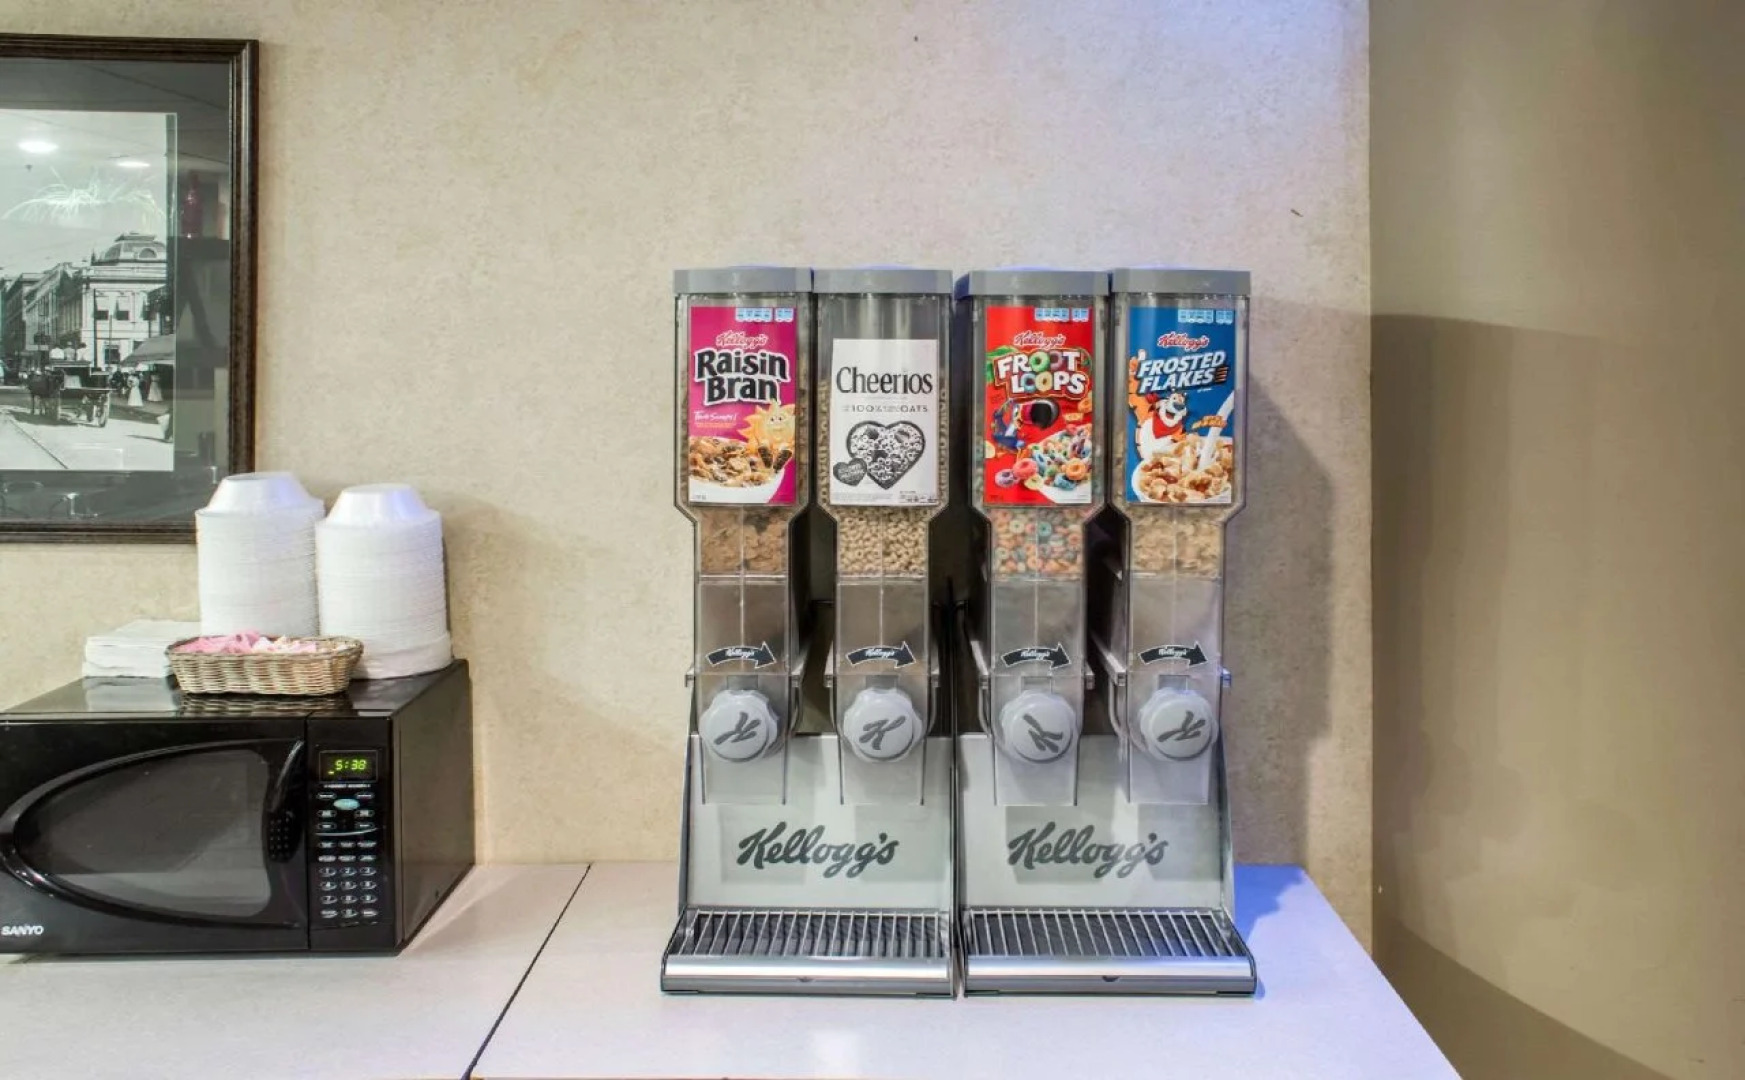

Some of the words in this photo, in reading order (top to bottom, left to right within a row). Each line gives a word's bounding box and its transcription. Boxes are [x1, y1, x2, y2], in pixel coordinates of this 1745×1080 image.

[1157, 331, 1209, 352] Kellogg's
[696, 349, 789, 381] Raisin
[997, 350, 1081, 378] FROOT
[1137, 351, 1226, 378] FROSTED
[706, 376, 778, 403] Bran
[836, 366, 933, 395] Cheerios
[1011, 371, 1086, 395] LOOPS
[1139, 367, 1216, 394] FLAKES
[858, 715, 907, 750] K
[334, 759, 367, 771] 5:38
[736, 821, 899, 878] Kellogg's
[1007, 821, 1169, 878] Kellogg's
[1, 925, 45, 936] SANYO
